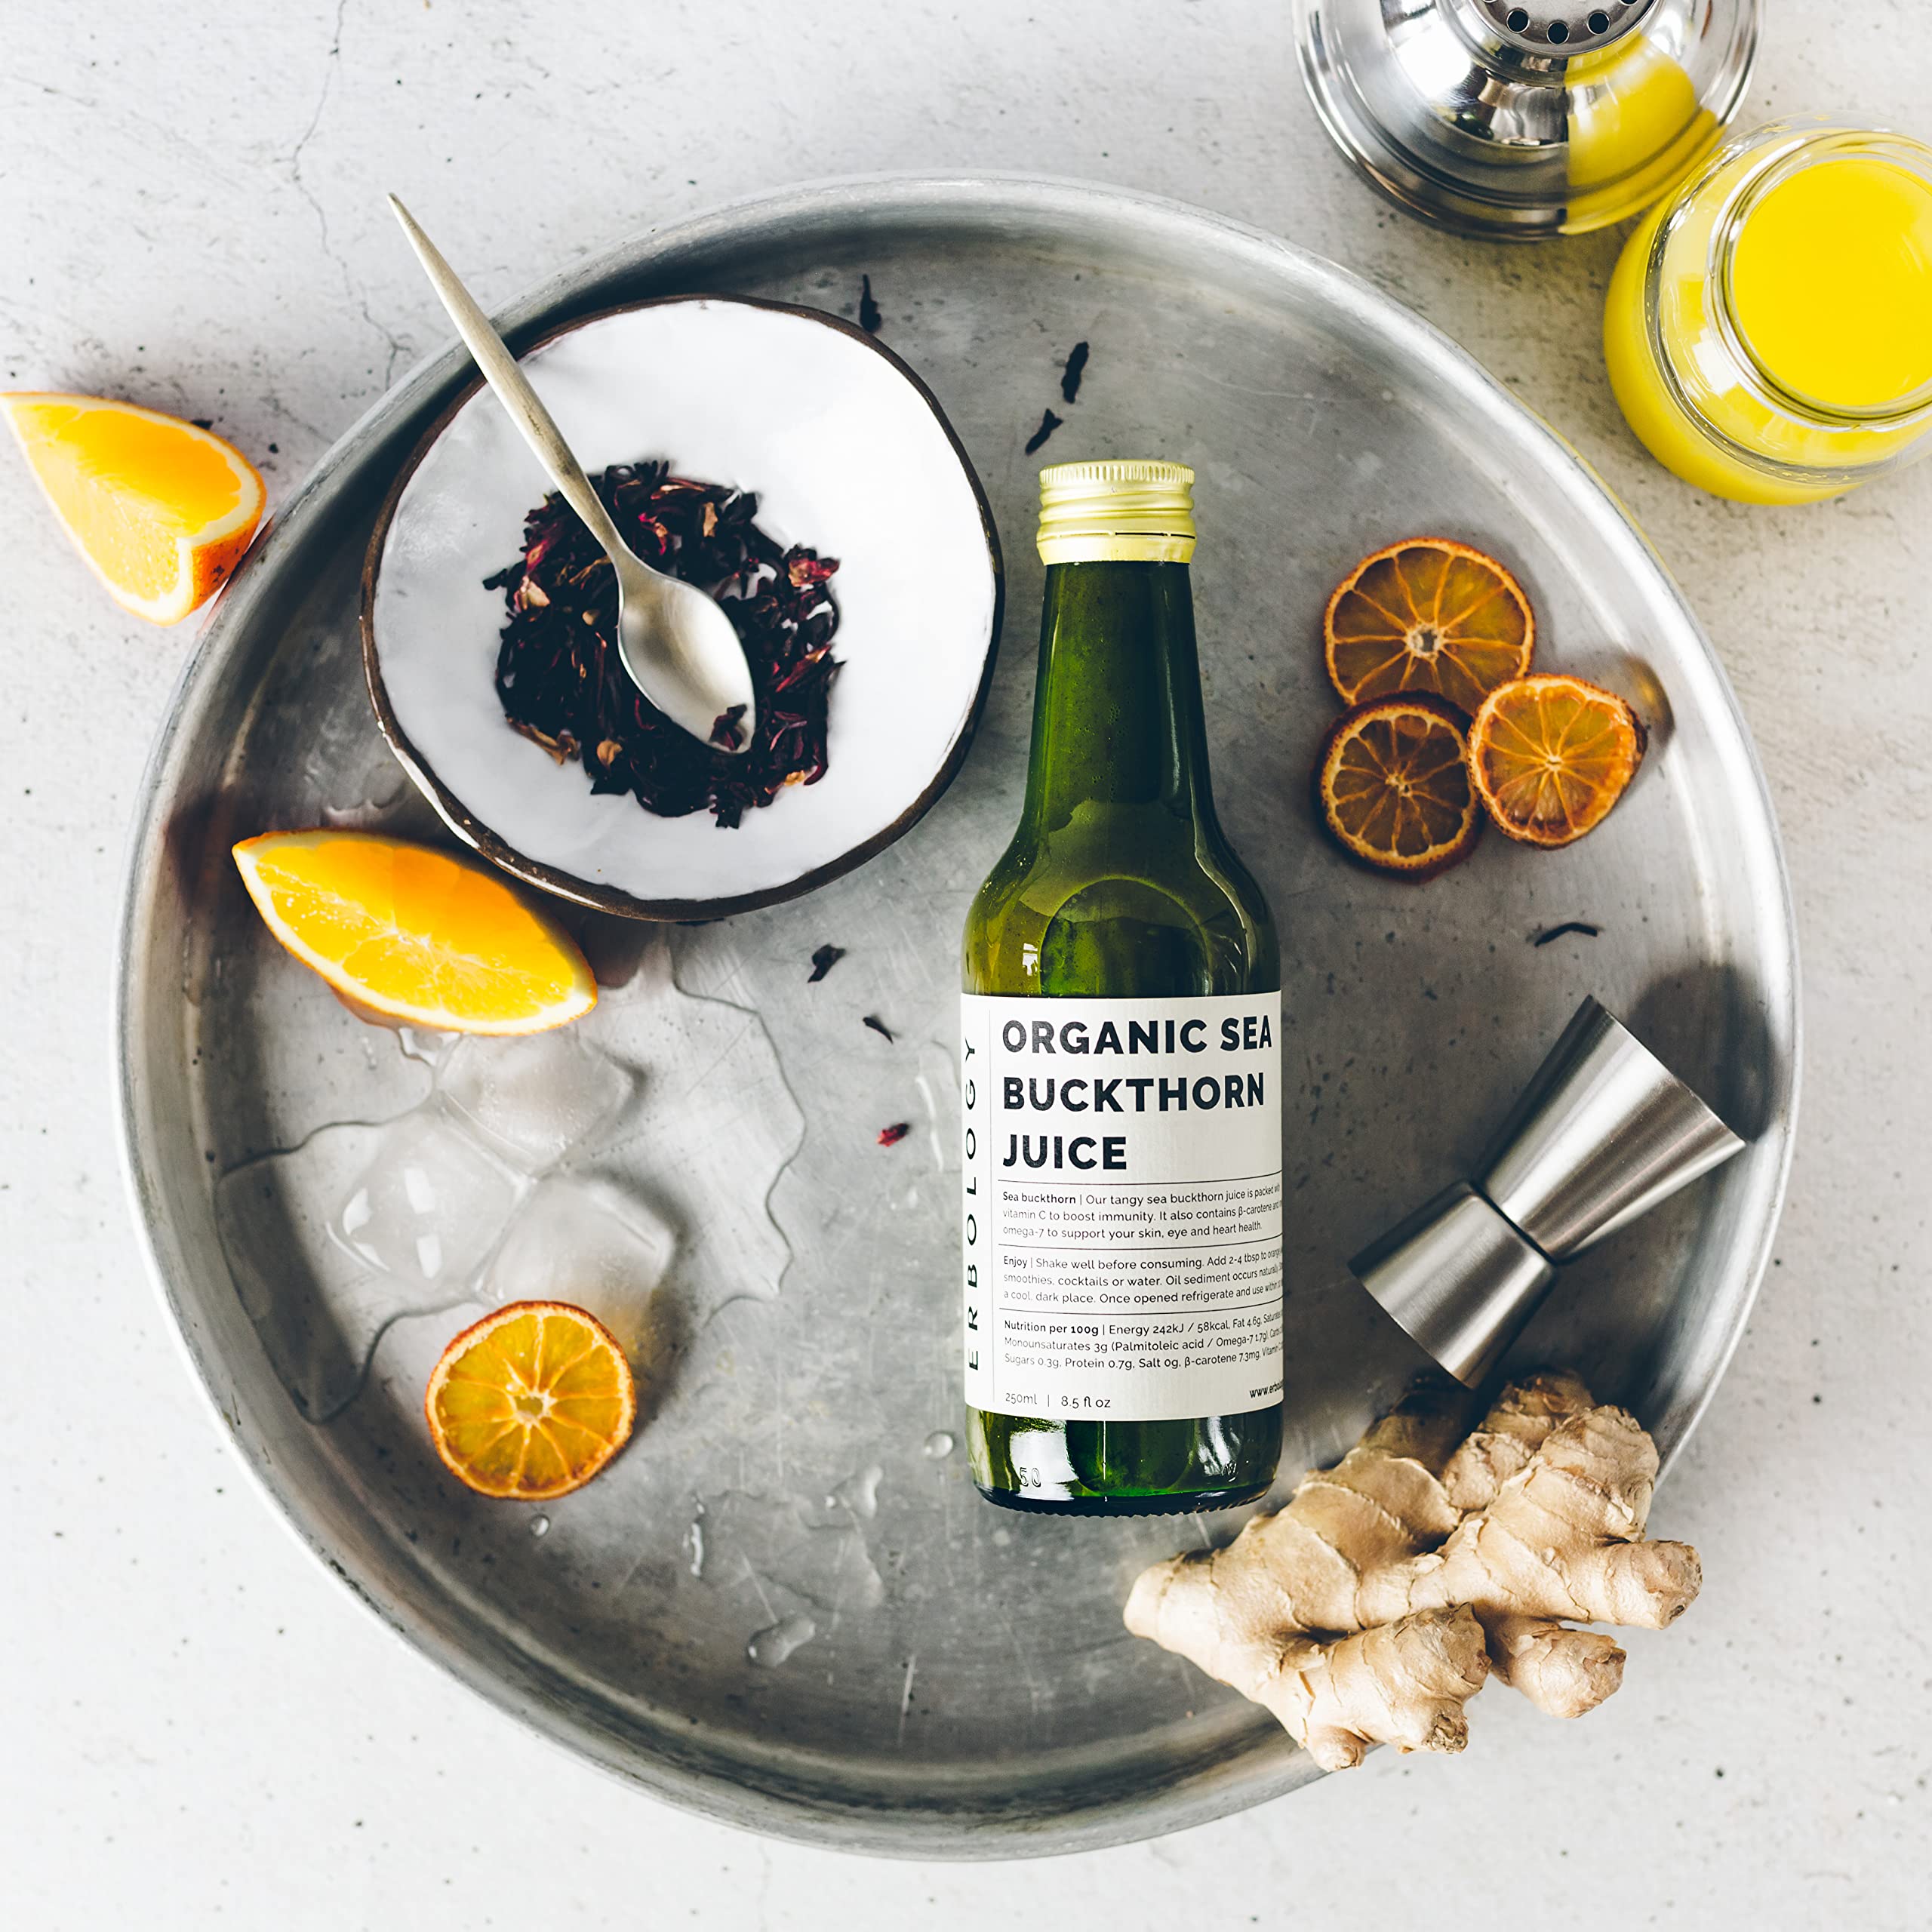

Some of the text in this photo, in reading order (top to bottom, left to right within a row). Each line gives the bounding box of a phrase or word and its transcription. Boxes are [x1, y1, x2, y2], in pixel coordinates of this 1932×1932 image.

[1003, 1015, 1272, 1054] ORGANIC SEA
[1004, 1072, 1263, 1112] BUCKTHORN
[1003, 1134, 1127, 1170] JUICE
[966, 1038, 979, 1371] ERBOLOGY
[1003, 1192, 1018, 1201] Sea
[1022, 1193, 1075, 1204] buckthorn
[1086, 1195, 1107, 1204] Our
[1111, 1195, 1143, 1207] tangy
[1171, 1192, 1223, 1203] buckthorn
[1225, 1190, 1245, 1202] juice
[1247, 1189, 1253, 1198] is
[1254, 1185, 1273, 1199] packed
[1003, 1208, 1035, 1219] vitamin
[1039, 1211, 1046, 1220] C
[1050, 1211, 1060, 1220] to
[1063, 1211, 1095, 1221] boost
[1100, 1211, 1155, 1223] immunity.
[1160, 1211, 1167, 1220] It
[1171, 1211, 1193, 1220] also
[1196, 1208, 1236, 1219] contains
[1003, 1220, 1262, 1241] omega-7 to support your skin, eye and heart health.
[1004, 1256, 1027, 1269] Enjoy
[1036, 1258, 1068, 1269] Shake
[1071, 1260, 1094, 1269] well
[1099, 1260, 1137, 1269] before
[1140, 1258, 1204, 1269] consuming.
[1207, 1256, 1226, 1266] Add
[1229, 1256, 1241, 1265] 2-4
[1244, 1253, 1260, 1263] tbsp
[1261, 1251, 1266, 1260] to
[1058, 1277, 1108, 1286] cocktails
[1128, 1277, 1162, 1286] water.
[1166, 1275, 1181, 1285] Oil
[1184, 1272, 1230, 1284] sediment
[1232, 1270, 1257, 1281] occurs
[1036, 1292, 1058, 1301] dark
[1063, 1293, 1095, 1304] place.
[1100, 1294, 1130, 1303] Once
[1134, 1292, 1178, 1305] opened
[1182, 1289, 1234, 1303] refrigerate
[1236, 1286, 1250, 1297] and
[1252, 1286, 1263, 1294] use
[1005, 1320, 1045, 1332] Nutrition
[1050, 1326, 1067, 1334] per
[1071, 1326, 1098, 1337] 100g
[1109, 1325, 1149, 1337] Energy
[1153, 1324, 1183, 1334] 242kJ
[1233, 1318, 1244, 1328] Fat
[1005, 1337, 1091, 1351] Monounsaturates
[1094, 1343, 1107, 1353] 3g
[1112, 1340, 1179, 1351] (Palmitoleic
[1182, 1338, 1204, 1349] acid
[1217, 1334, 1254, 1347] Omega-7
[1005, 1353, 1035, 1366] Sugars
[1066, 1358, 1104, 1367] Protein
[1139, 1358, 1161, 1367] Salt
[1006, 1393, 1037, 1404] 250ml
[1061, 1396, 1078, 1409] 8.5
[1084, 1396, 1091, 1407] fl
[1096, 1399, 1110, 1407] oz
